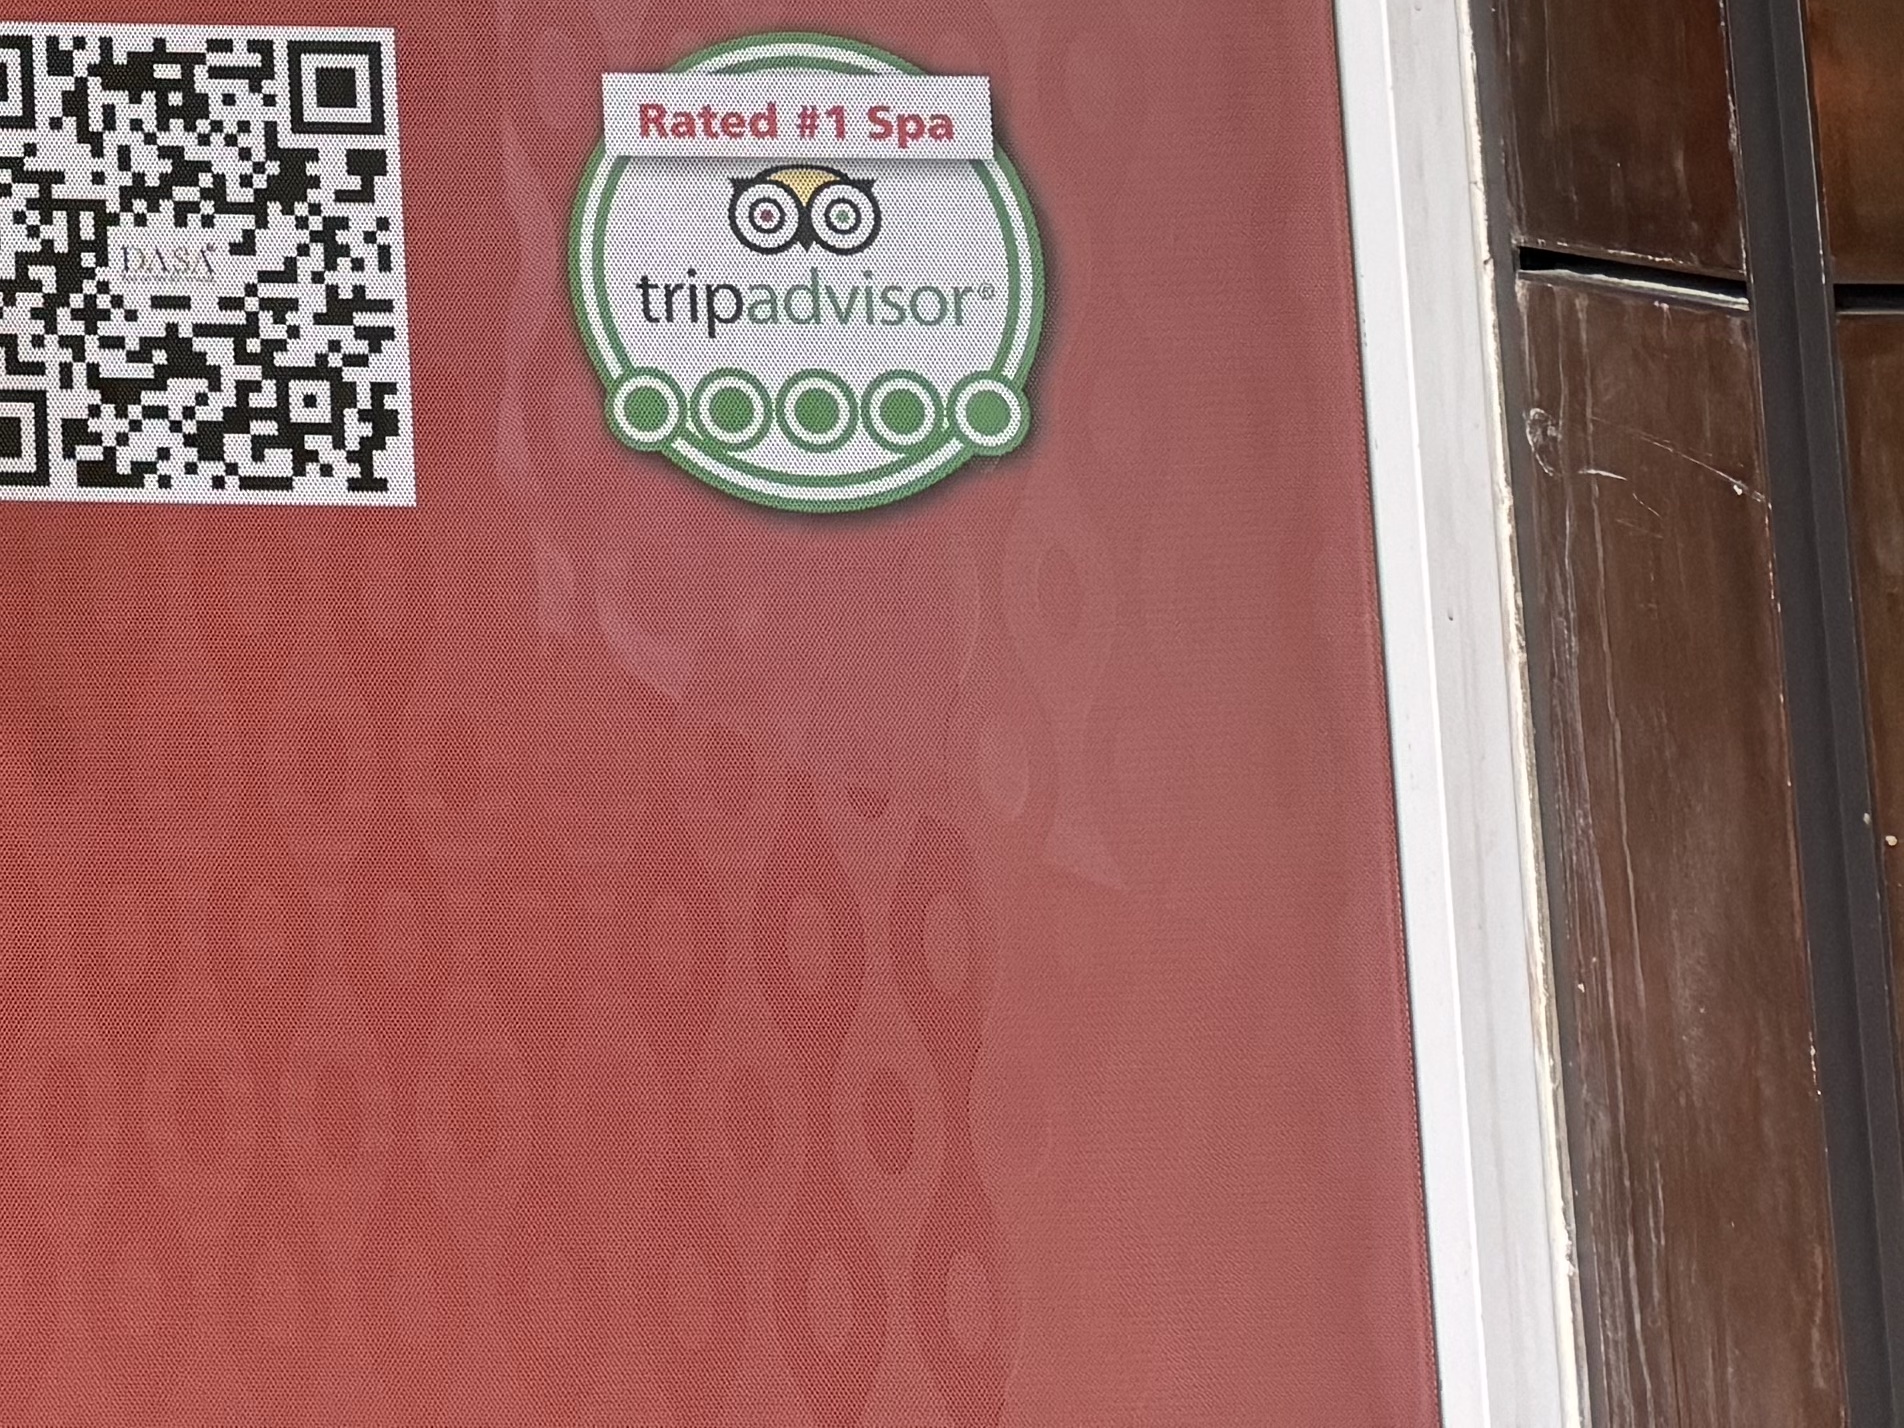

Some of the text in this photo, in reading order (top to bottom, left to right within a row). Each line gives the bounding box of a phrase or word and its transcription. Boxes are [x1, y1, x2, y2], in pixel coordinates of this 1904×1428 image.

[638, 102, 955, 148] Rated #1 Spa
